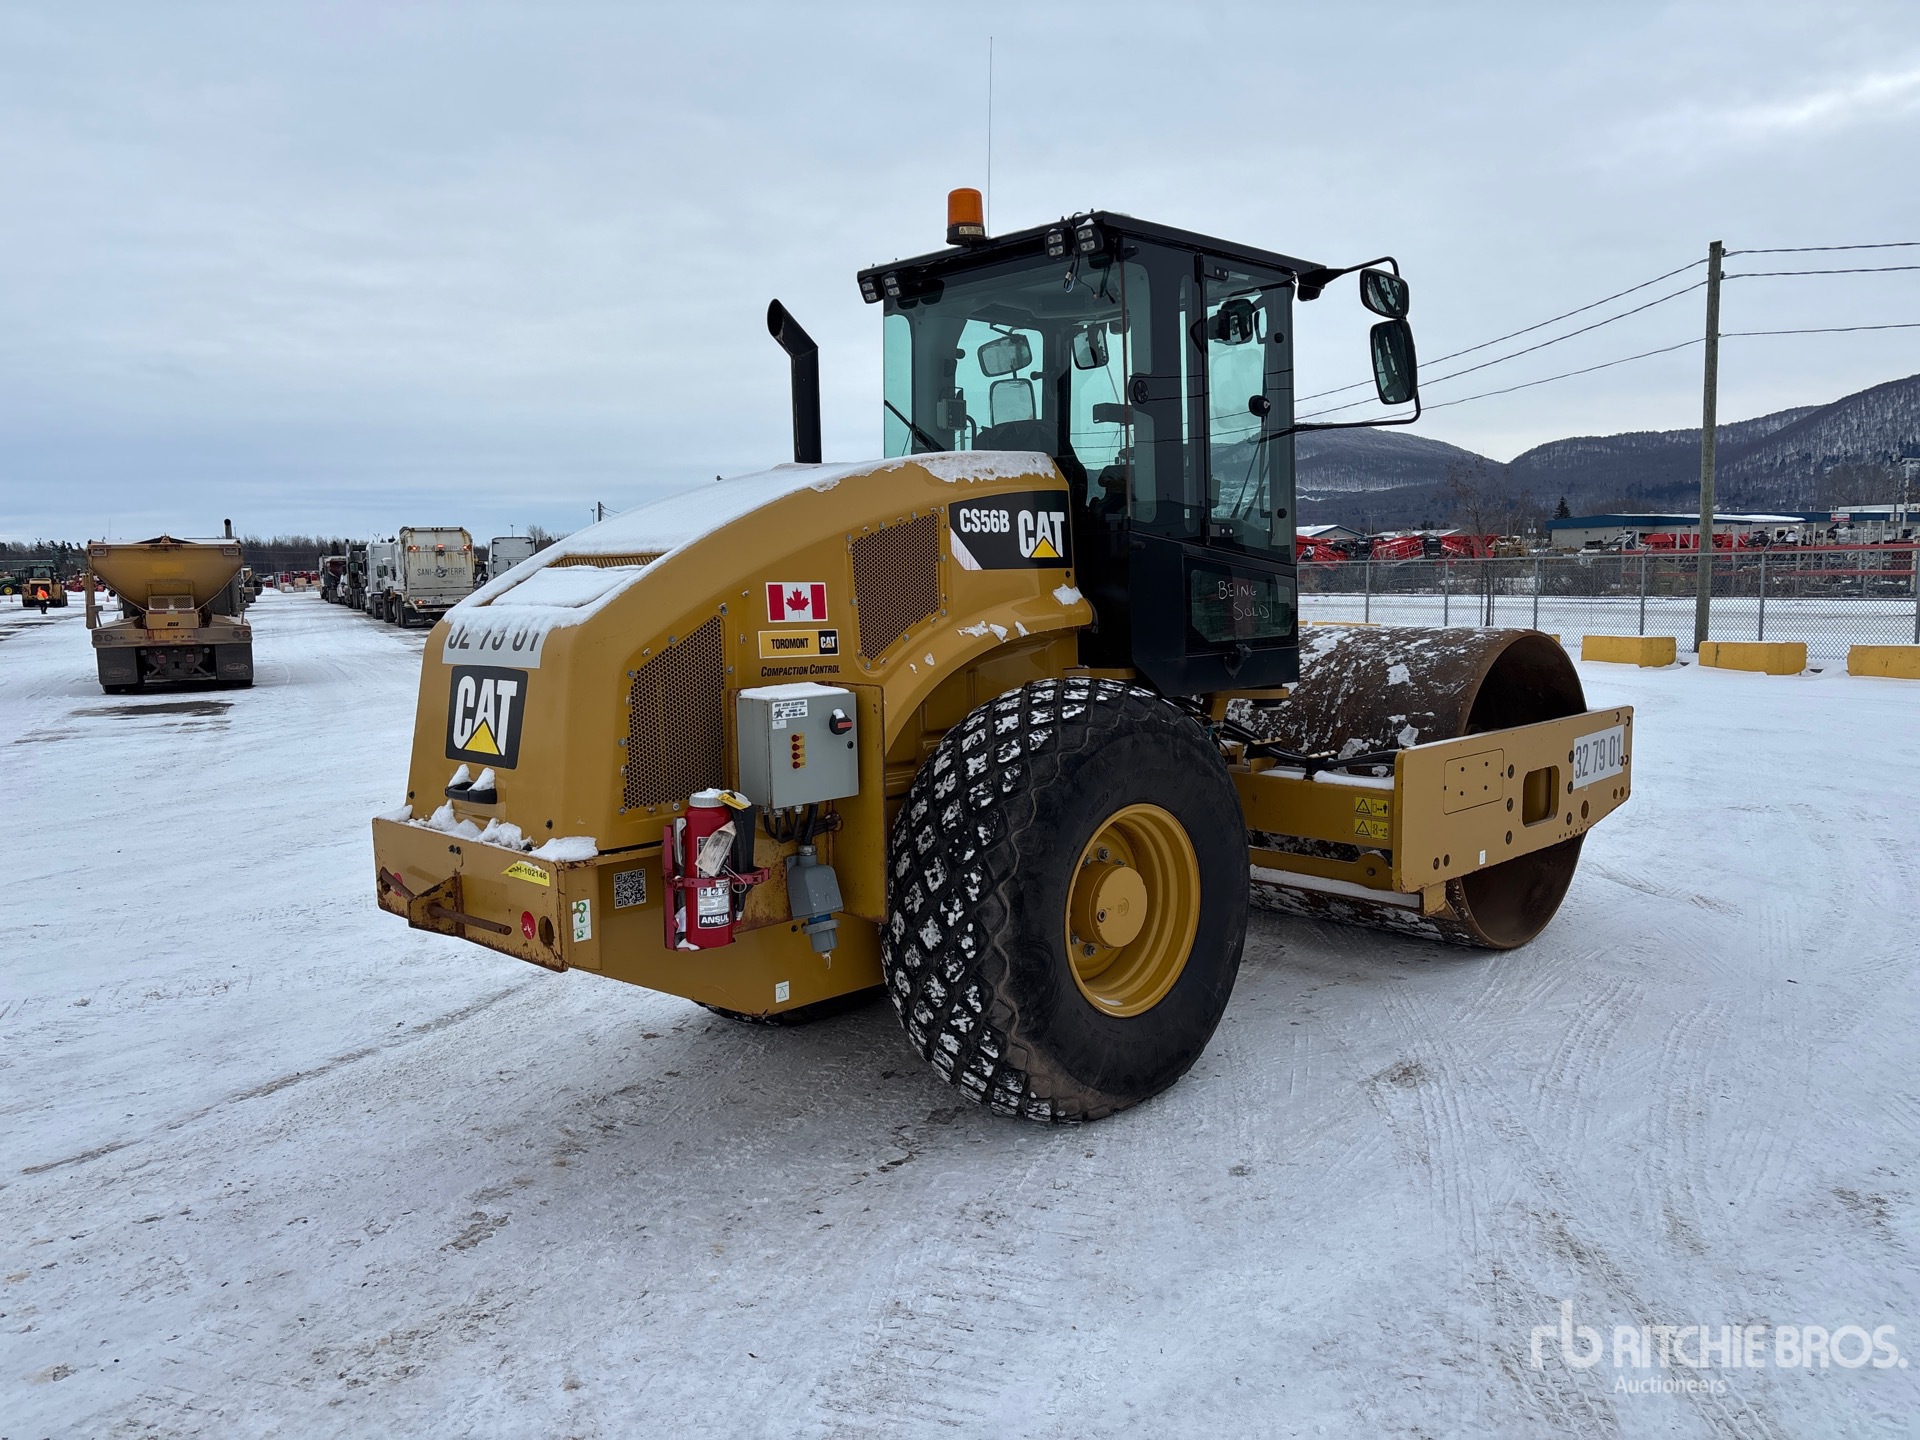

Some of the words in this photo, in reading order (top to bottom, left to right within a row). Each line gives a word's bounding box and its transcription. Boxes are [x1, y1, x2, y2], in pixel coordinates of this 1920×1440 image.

[959, 507, 1010, 533] CS56B
[1017, 509, 1065, 558] CAT
[447, 567, 466, 576] TERRE
[1217, 580, 1257, 600] BEING
[1232, 602, 1270, 621] SOLD
[771, 638, 809, 650] TOROMONT
[820, 636, 836, 649] CAT
[761, 665, 808, 677] COMPACTION
[809, 663, 841, 675] CONTROL
[453, 675, 518, 757] CAT
[1575, 744, 1588, 779] 32
[1593, 738, 1606, 773] 79
[1609, 734, 1621, 768] 01
[701, 914, 729, 924] ANSUL
